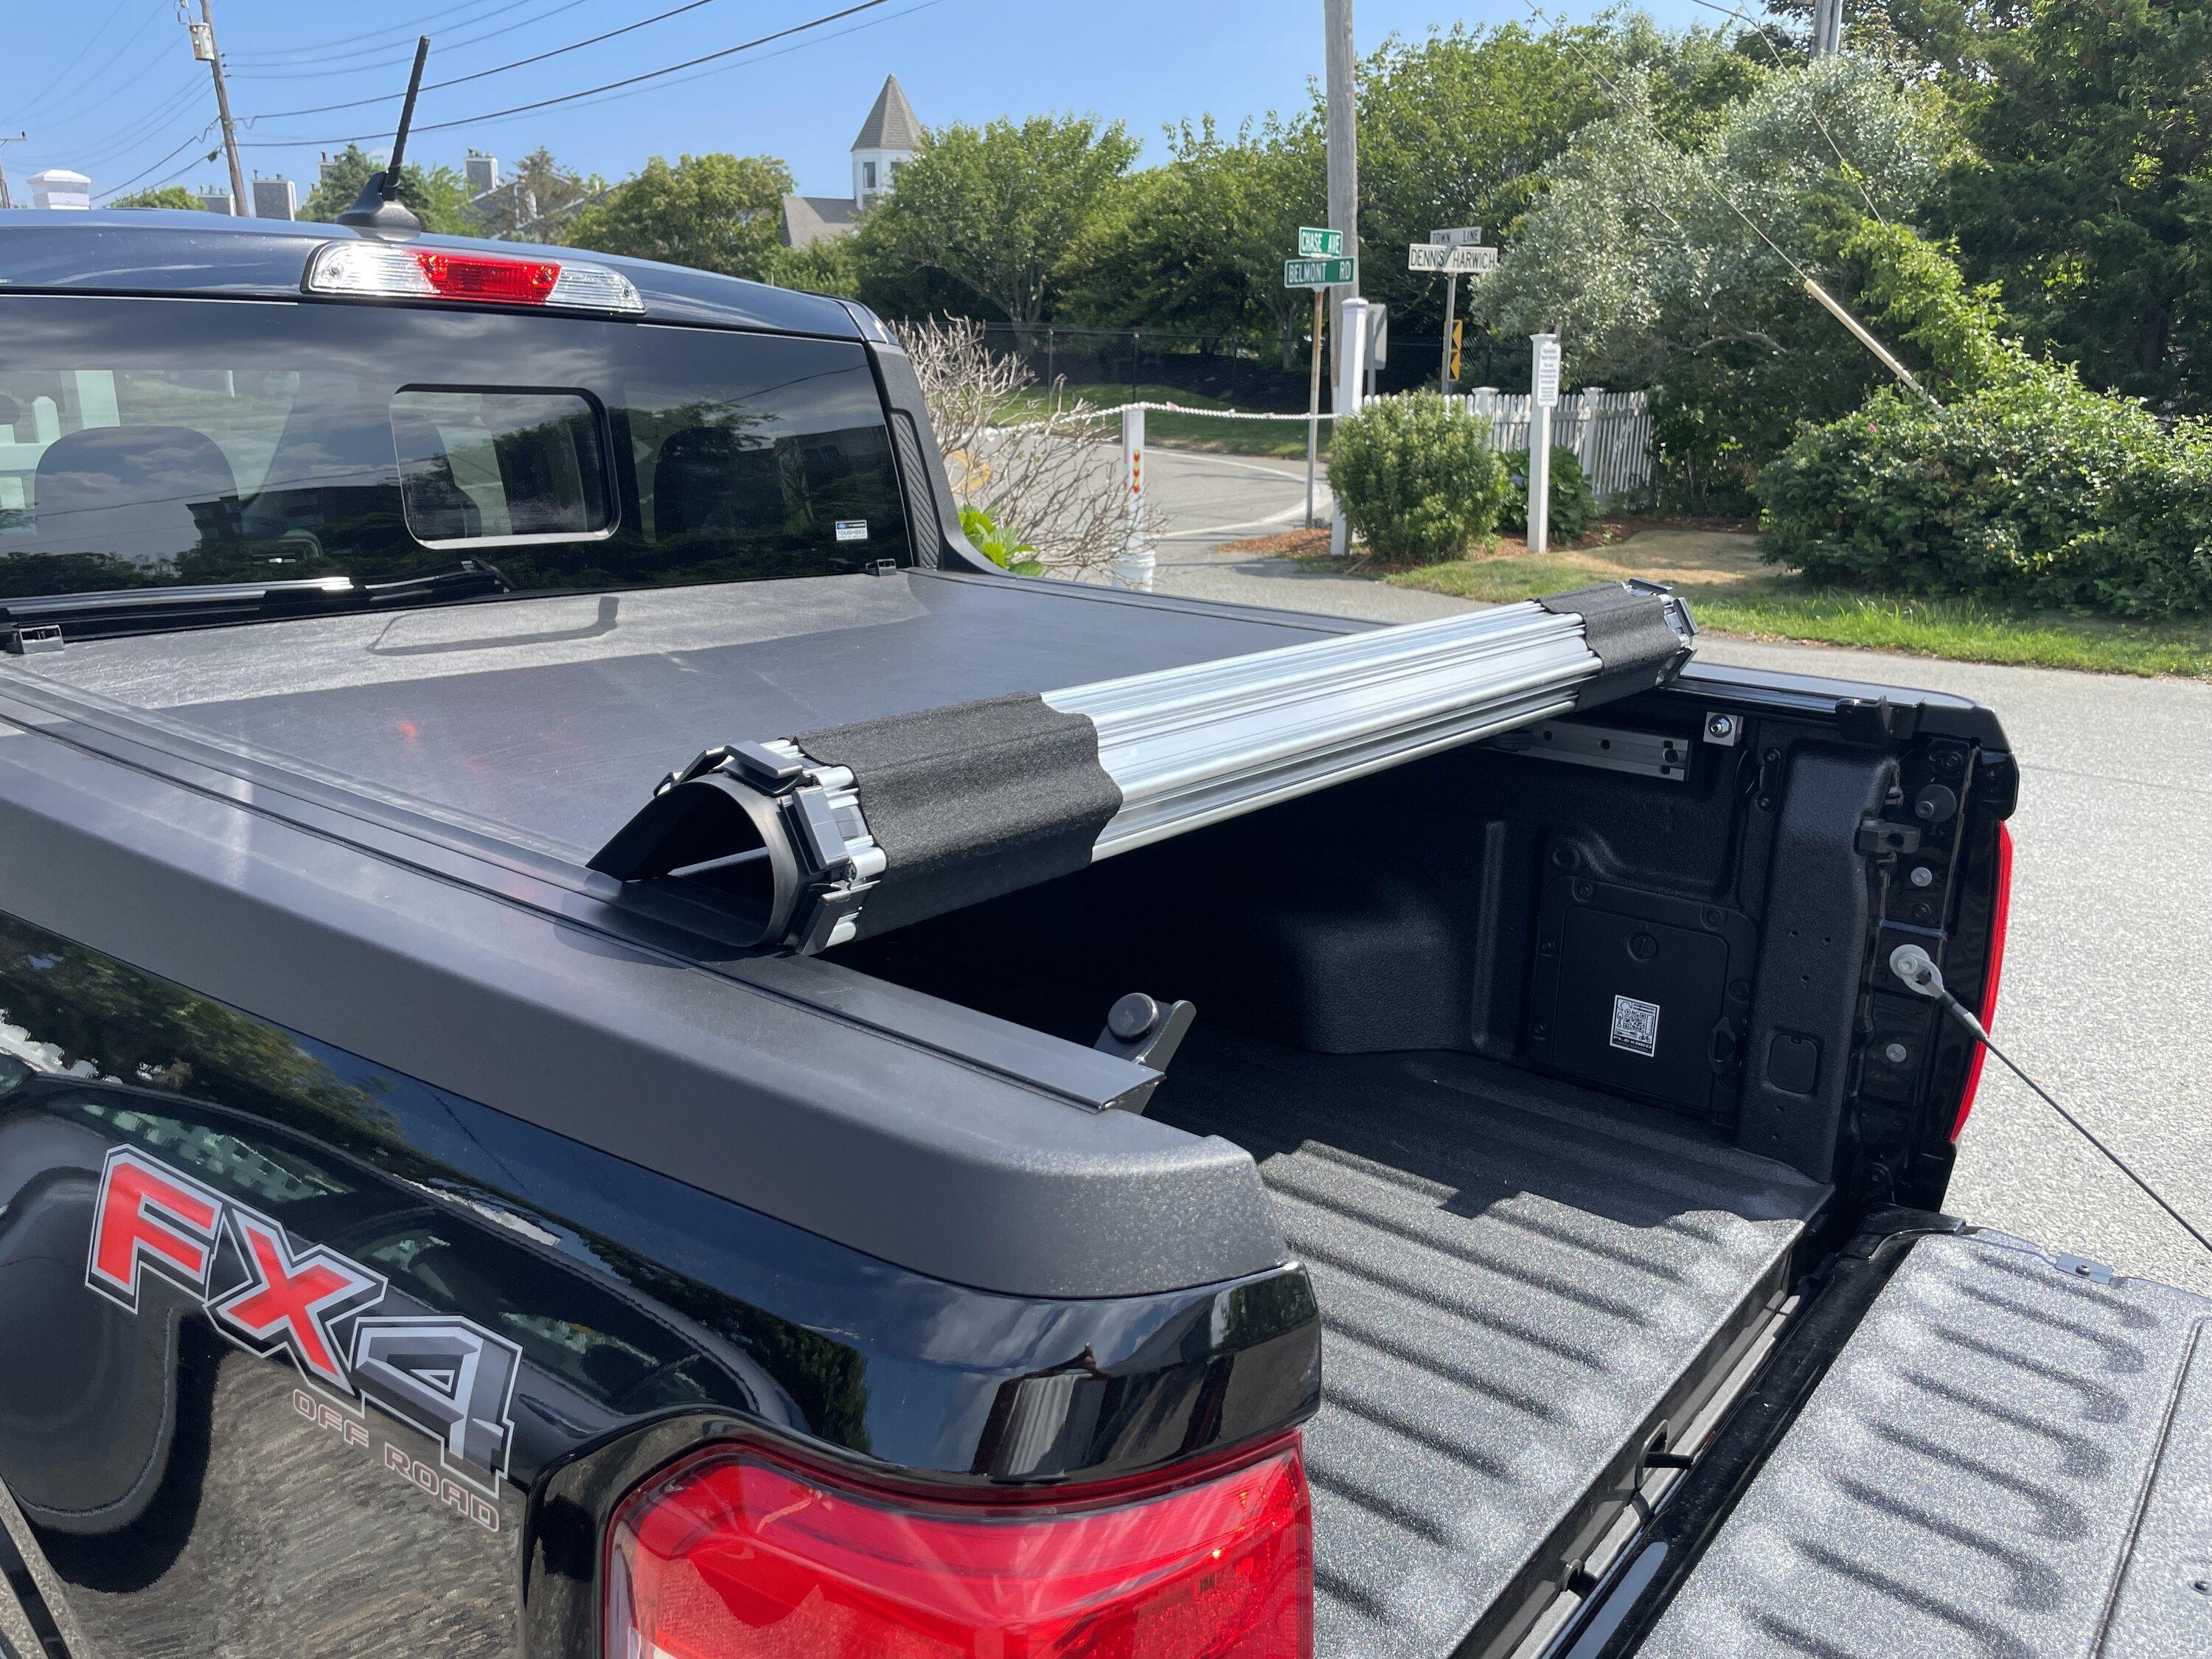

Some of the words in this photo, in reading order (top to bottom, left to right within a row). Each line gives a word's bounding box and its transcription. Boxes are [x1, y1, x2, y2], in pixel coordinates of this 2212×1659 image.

[1301, 231, 1323, 253] CHASE
[1327, 234, 1340, 255] AVE
[1463, 229, 1478, 243] LINE
[1288, 262, 1326, 283] BELMONT
[1339, 260, 1352, 280] RD
[1453, 250, 1495, 270] HARWICH
[86, 1143, 524, 1498] FX4
[293, 1388, 369, 1447] OFF
[384, 1441, 499, 1532] ROAD
